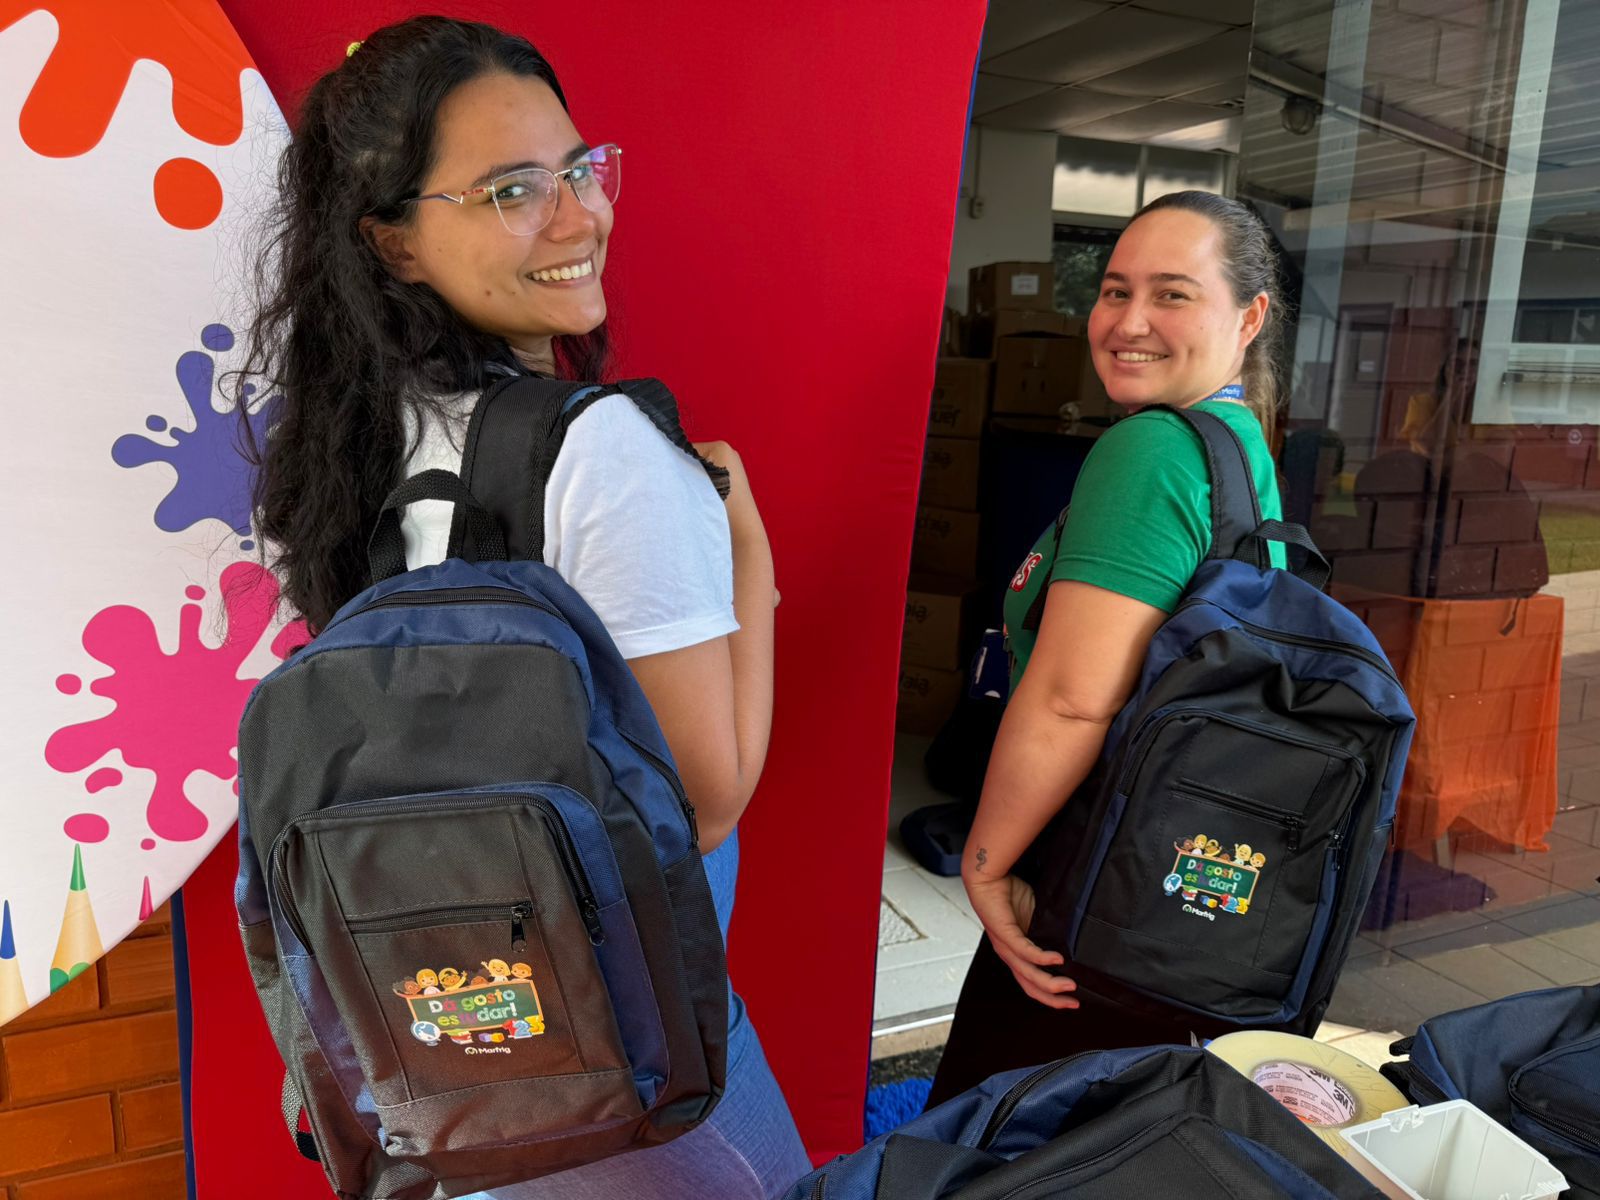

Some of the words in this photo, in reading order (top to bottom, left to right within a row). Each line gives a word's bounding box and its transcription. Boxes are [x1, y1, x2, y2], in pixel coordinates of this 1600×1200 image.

[1205, 865, 1241, 881] gosto
[1193, 908, 1215, 921] Marfrig
[462, 989, 515, 1011] gosto
[478, 1046, 512, 1054] Marfrig
[1333, 1089, 1348, 1109] 3M
